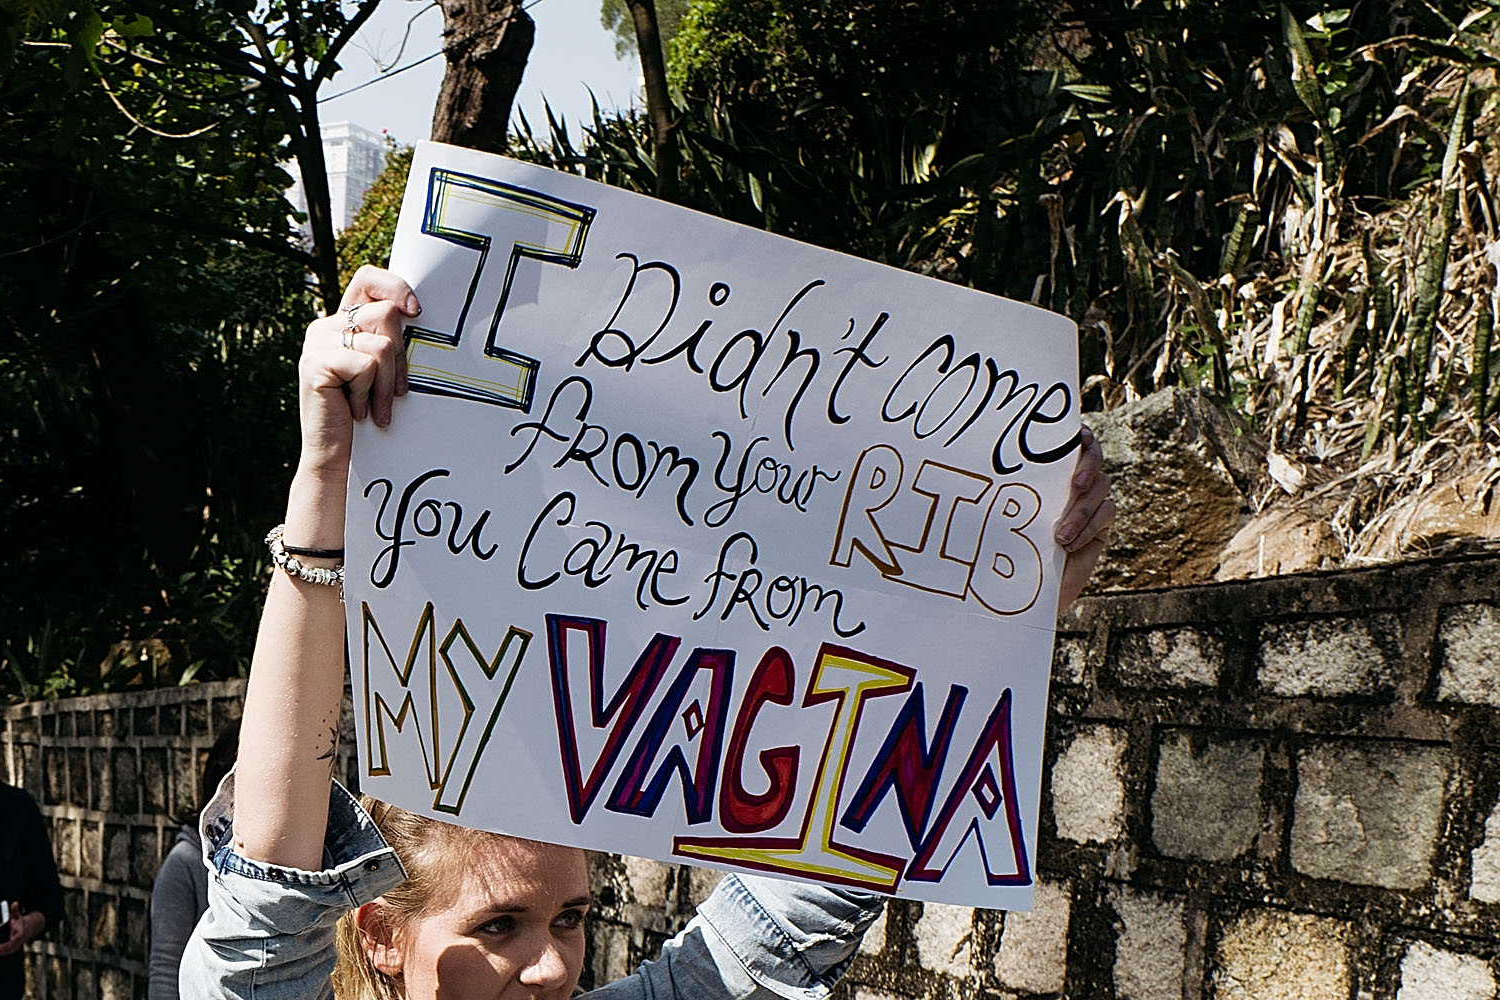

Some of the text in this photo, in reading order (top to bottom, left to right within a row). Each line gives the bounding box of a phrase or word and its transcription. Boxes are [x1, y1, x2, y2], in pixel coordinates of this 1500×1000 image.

[404, 167, 596, 413] I
[574, 253, 889, 451] Didn't
[363, 468, 499, 589] You
[829, 444, 1043, 616] RIB
[361, 600, 1033, 894] MY VAGINA
